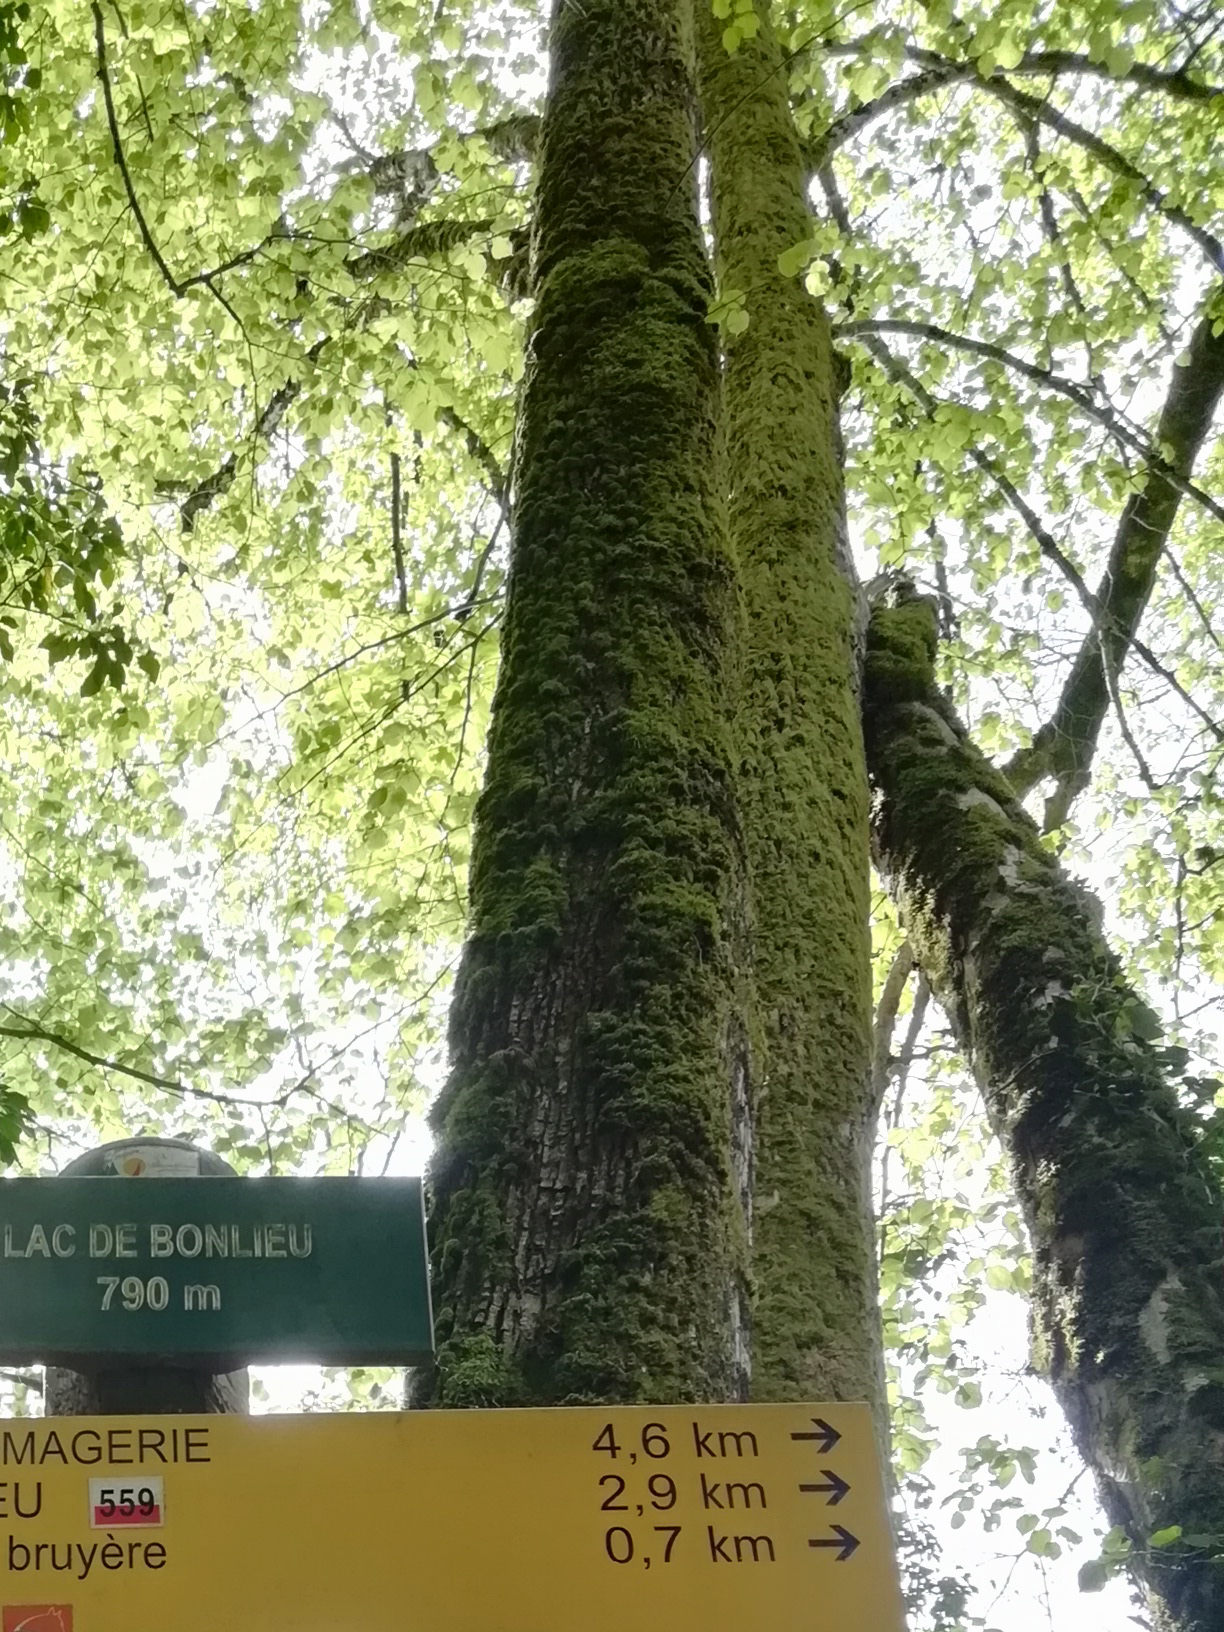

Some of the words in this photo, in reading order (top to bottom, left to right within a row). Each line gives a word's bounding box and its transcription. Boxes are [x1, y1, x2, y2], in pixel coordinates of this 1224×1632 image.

[3, 1223, 76, 1258] LAC
[88, 1223, 138, 1258] DE
[150, 1222, 313, 1259] BONLIEU
[96, 1276, 170, 1312] 790
[184, 1283, 222, 1312] m
[592, 1422, 671, 1465] 4,6
[692, 1421, 759, 1458] km
[98, 1488, 156, 1518] 559
[598, 1473, 678, 1517] 2,9
[700, 1472, 768, 1510] km
[8, 1533, 167, 1581] bruyère
[605, 1525, 682, 1570] 0,7
[707, 1525, 776, 1562] km
